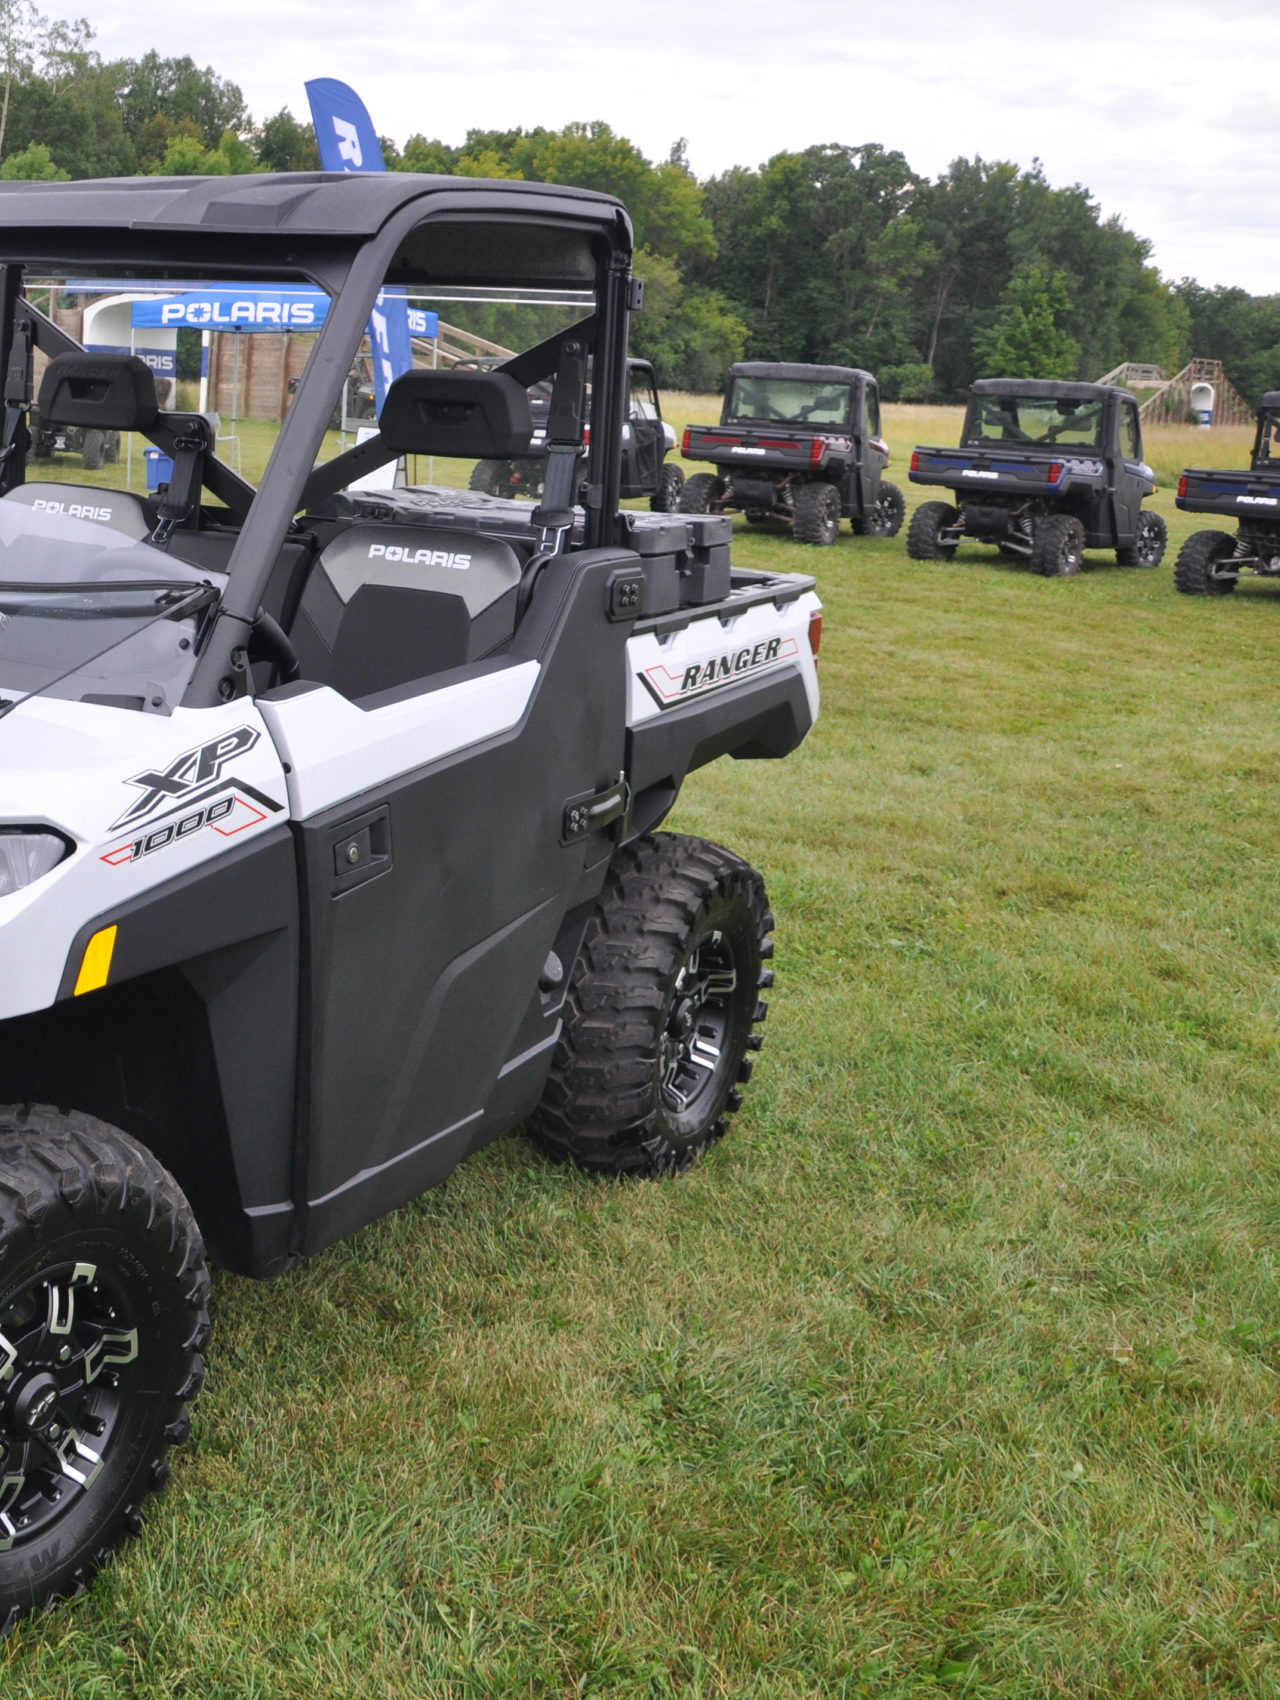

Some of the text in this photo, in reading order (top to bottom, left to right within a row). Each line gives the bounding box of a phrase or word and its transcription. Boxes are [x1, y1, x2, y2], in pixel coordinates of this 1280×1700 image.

[161, 301, 314, 324] POLARIS
[32, 498, 112, 522] POLARIS
[368, 543, 472, 570] POLARIS
[679, 636, 783, 692] RANGER
[106, 724, 262, 832] XP
[129, 793, 237, 864] 1000
